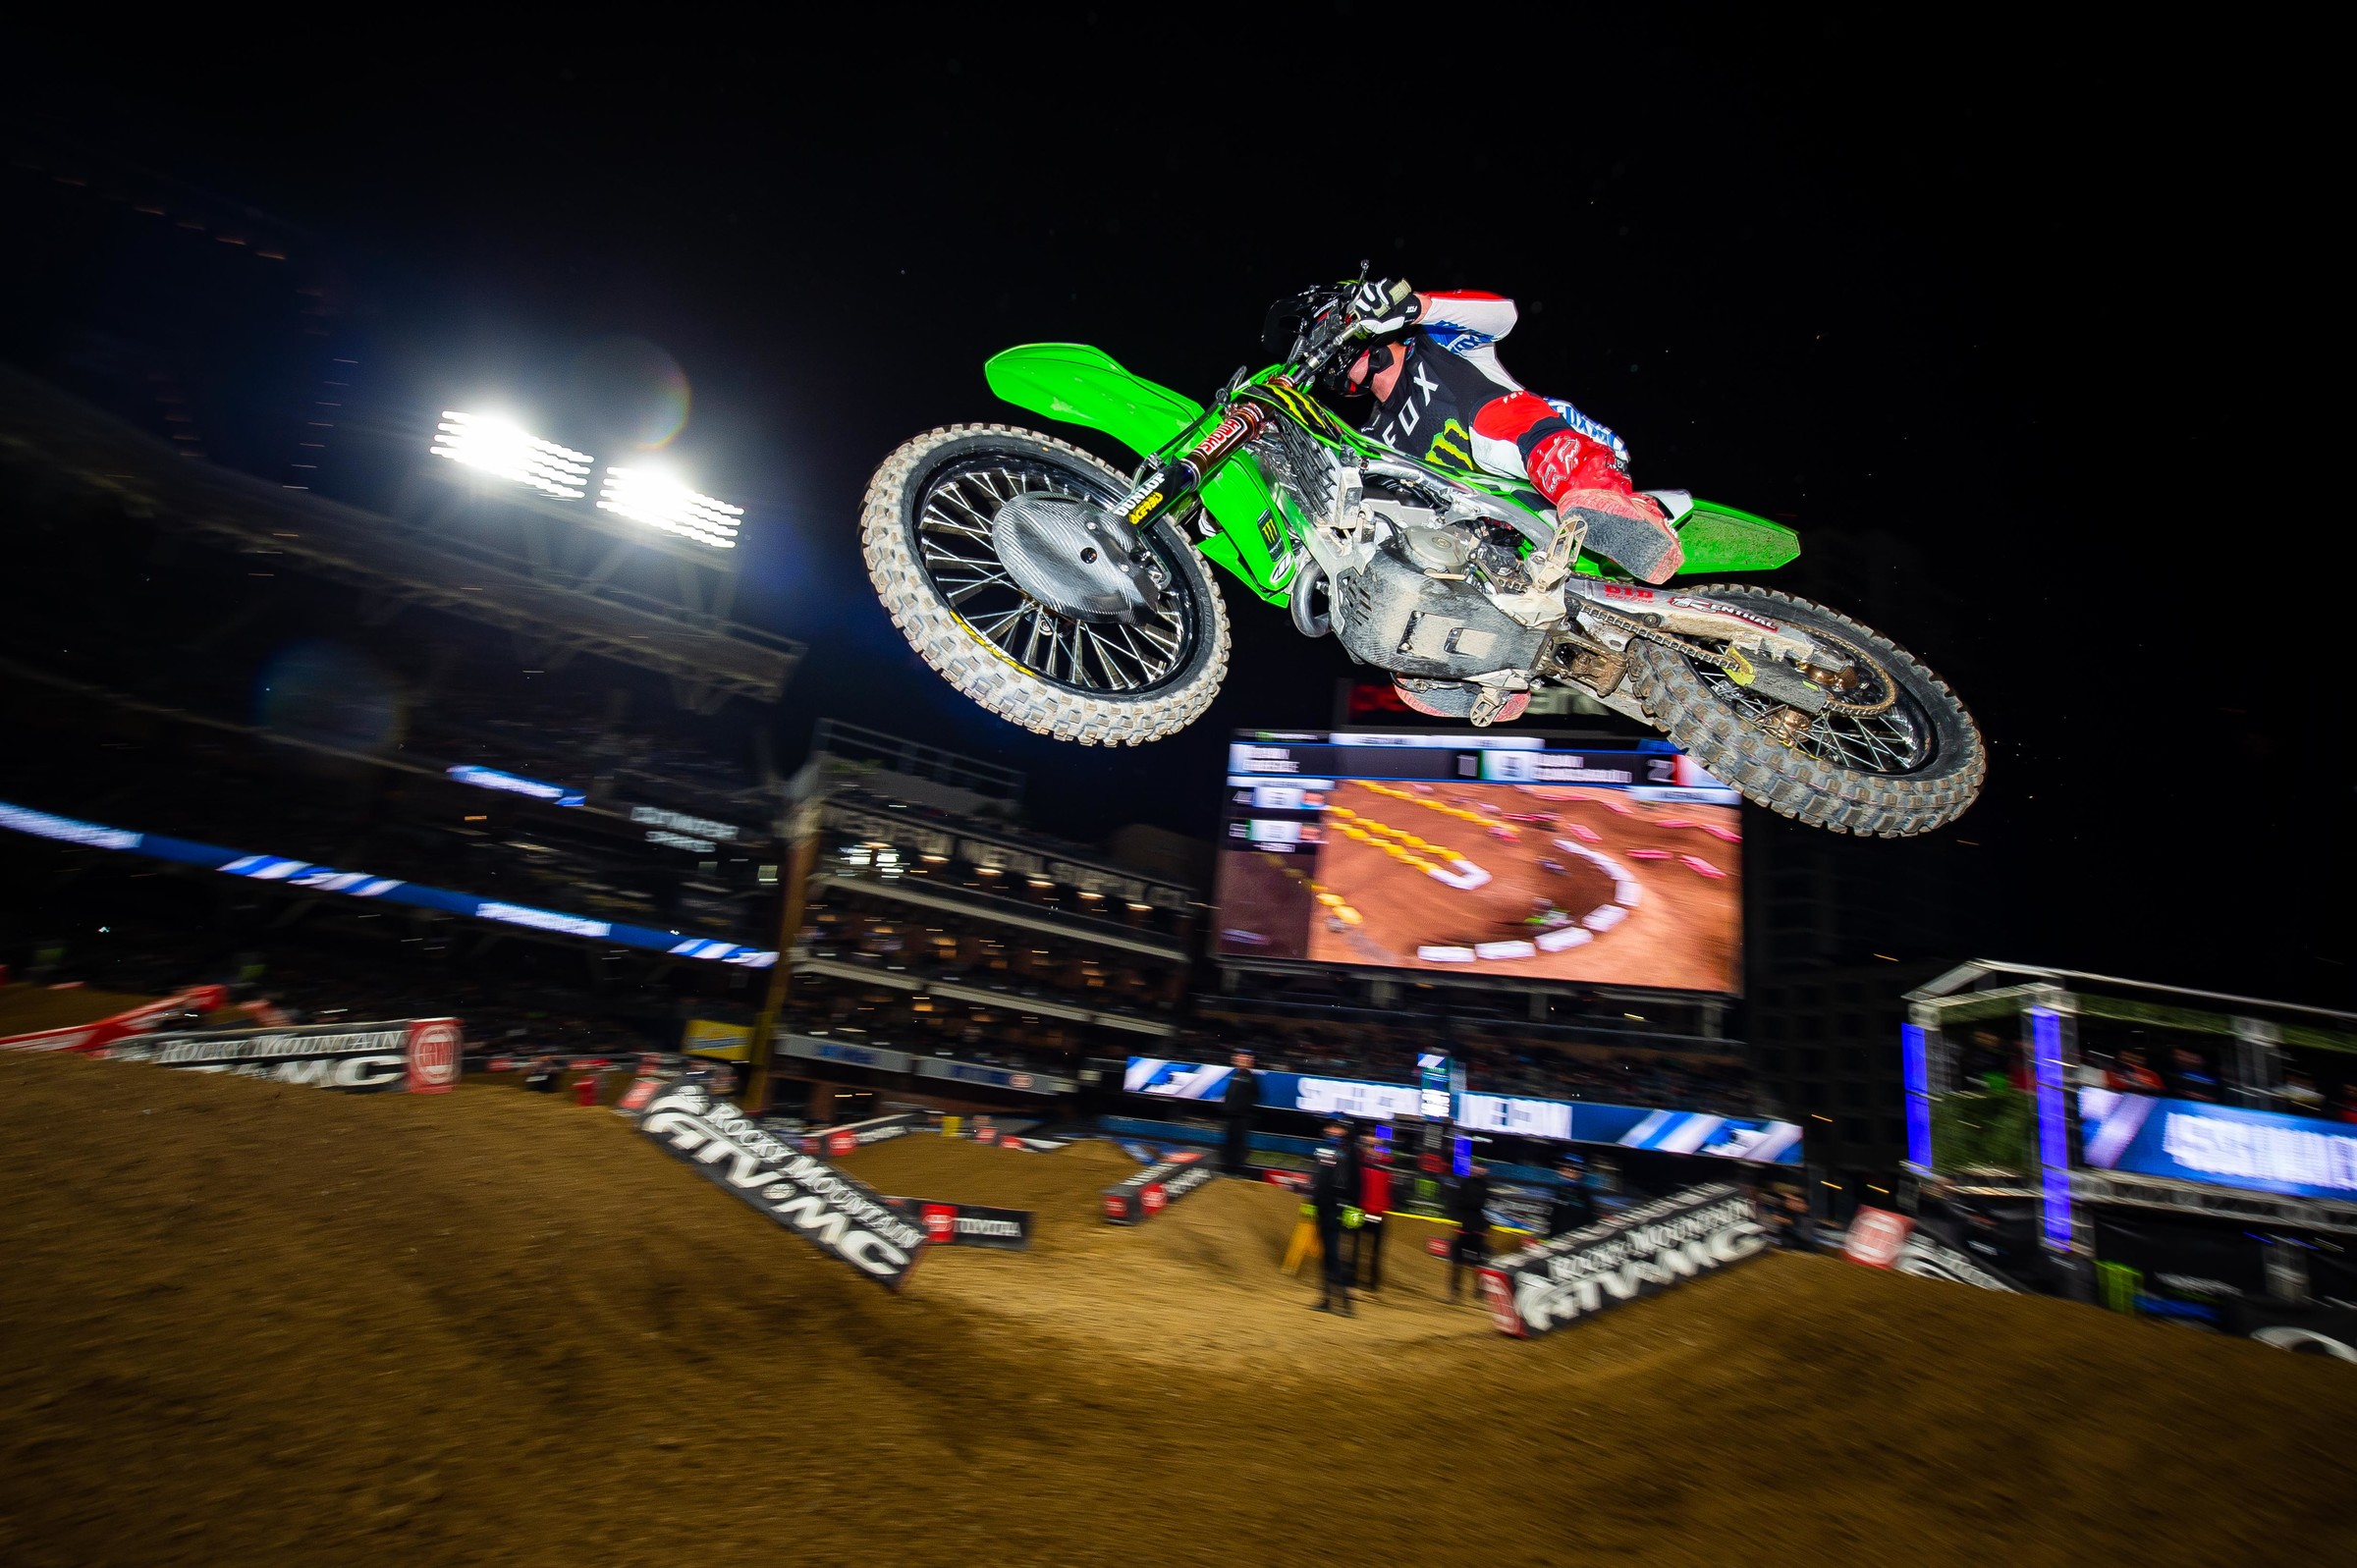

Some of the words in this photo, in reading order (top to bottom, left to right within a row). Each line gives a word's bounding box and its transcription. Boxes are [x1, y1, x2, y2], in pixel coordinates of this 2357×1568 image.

[1383, 361, 1439, 449] FOX
[1199, 418, 1241, 455] SHOWA
[1113, 472, 1166, 516] DUNLOP
[157, 1039, 247, 1064] ROCKY
[248, 1031, 406, 1057] MOUNTAIN
[705, 1102, 792, 1163] ROCKY
[787, 1154, 926, 1250] MOUNTAIN
